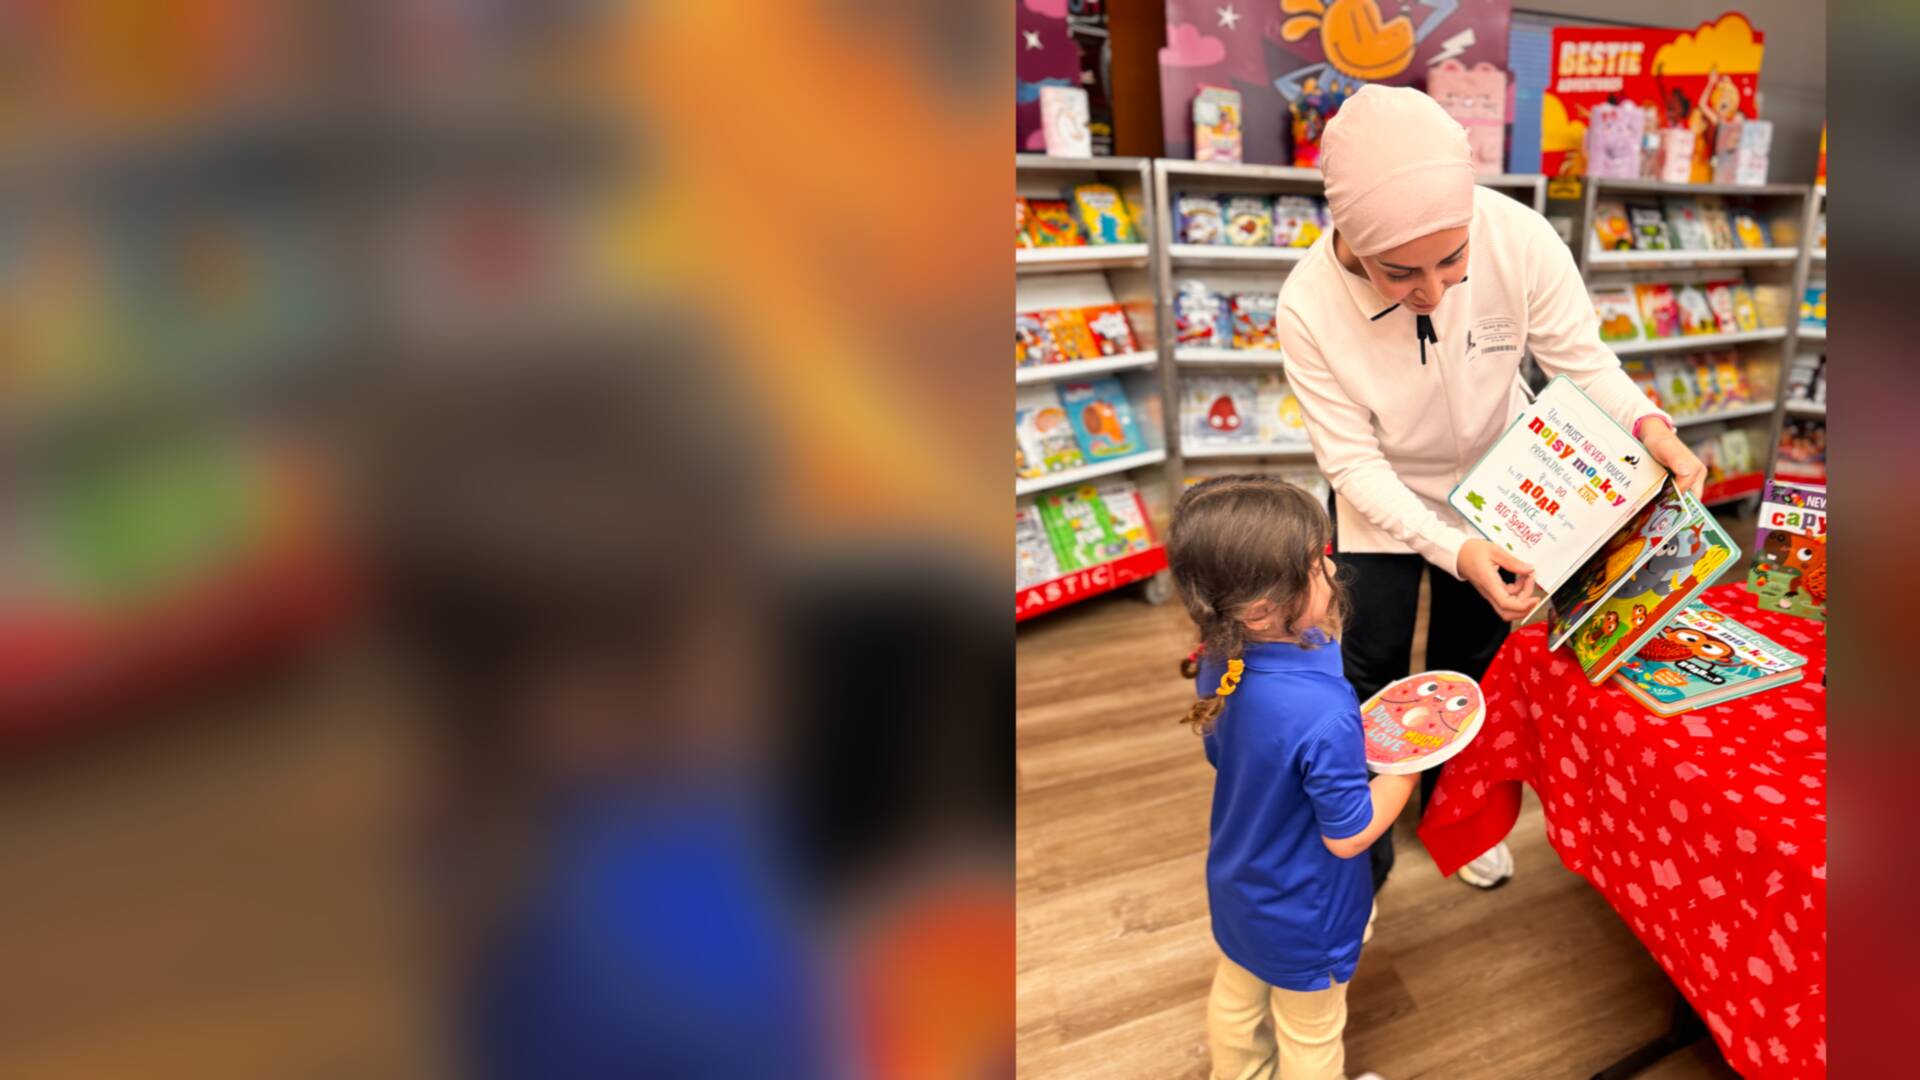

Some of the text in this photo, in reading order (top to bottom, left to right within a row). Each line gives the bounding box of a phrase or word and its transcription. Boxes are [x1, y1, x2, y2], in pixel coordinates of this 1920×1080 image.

[1559, 42, 1644, 76] BESTIE
[1528, 416, 1627, 507] noisy monkey
[1530, 443, 1564, 476] PROWLING
[1561, 422, 1584, 443] MUST
[1581, 440, 1606, 464] NEVER
[1603, 461, 1626, 483] TOUCH
[1623, 480, 1632, 488] A
[1494, 501, 1511, 518] BIG
[1508, 492, 1540, 521] POUNCE
[1519, 478, 1560, 516] ROAR
[1016, 566, 1109, 614] ASTIC
[1368, 728, 1406, 752] LOVE
[1402, 730, 1445, 749] MUCH
